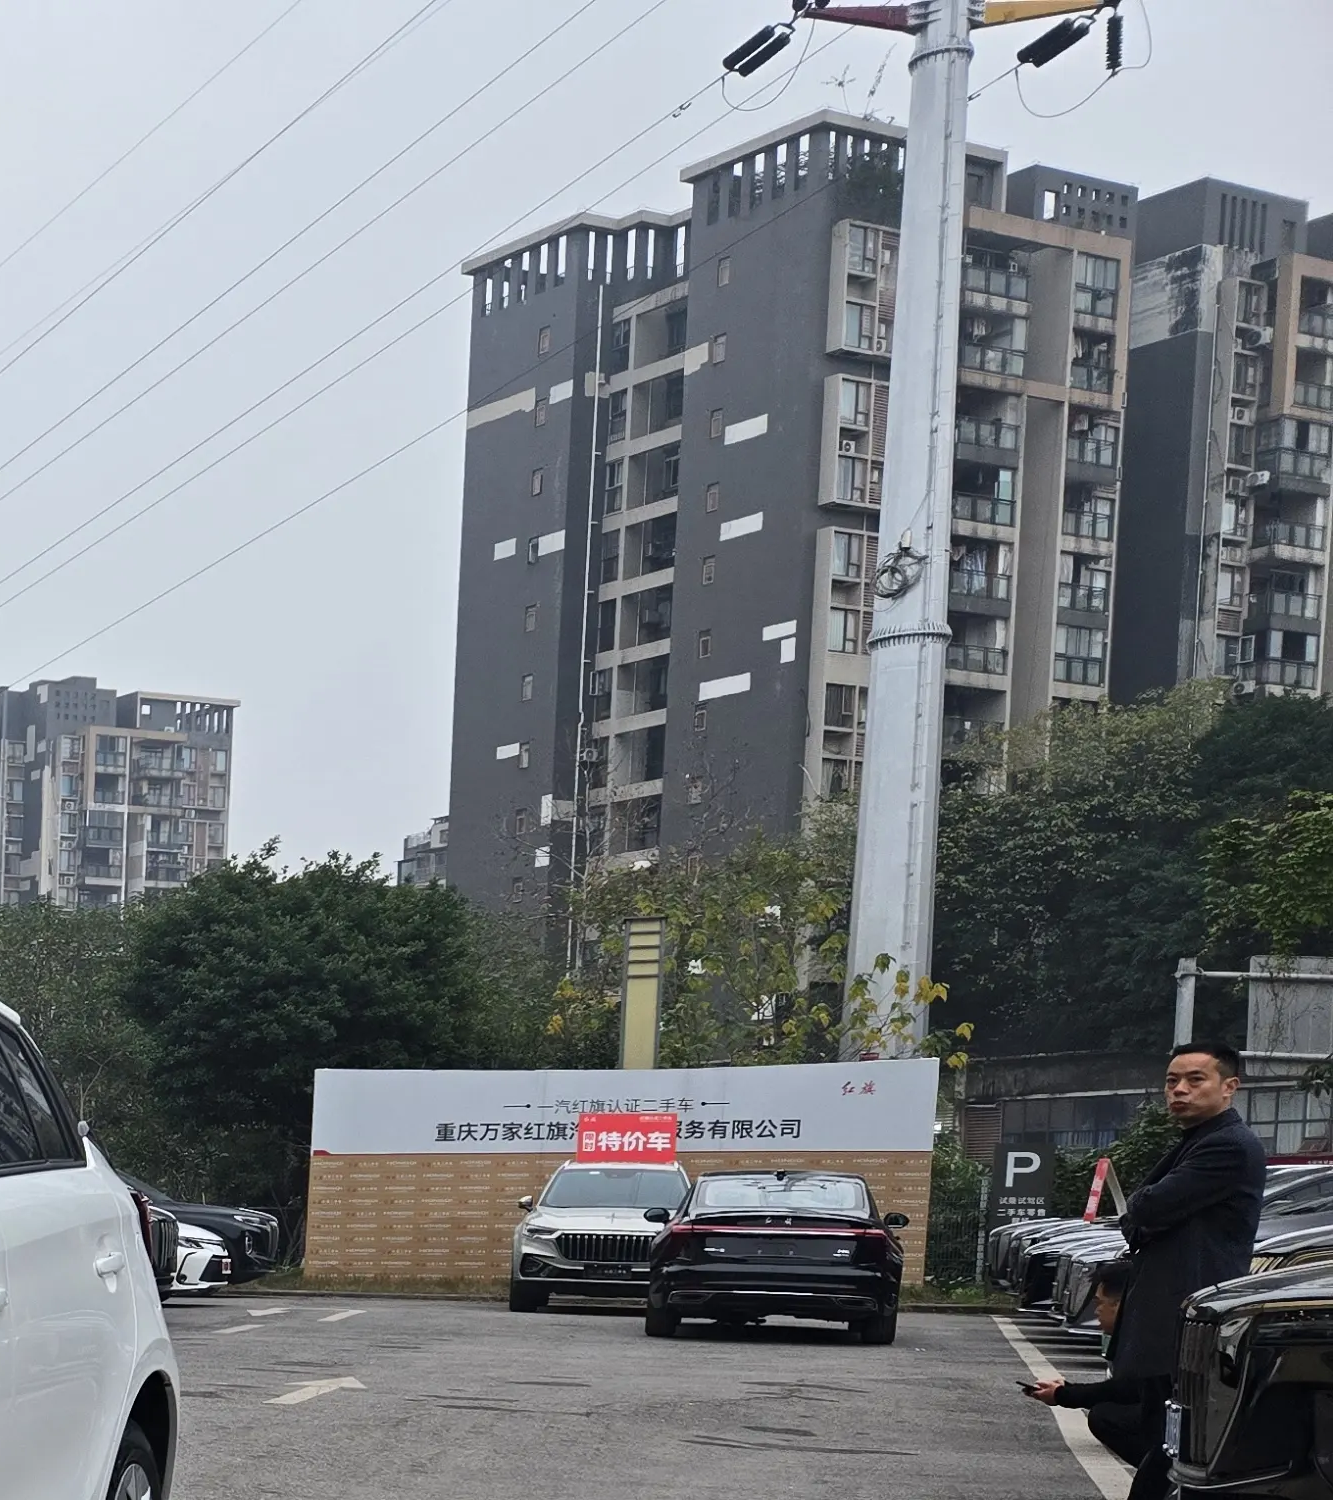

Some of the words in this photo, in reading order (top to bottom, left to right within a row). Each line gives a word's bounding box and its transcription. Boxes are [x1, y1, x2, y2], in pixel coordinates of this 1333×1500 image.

[537, 1097, 695, 1114] 一汽红旗认证二手车
[597, 1131, 672, 1152] 特价车
[1005, 1151, 1041, 1188] P
